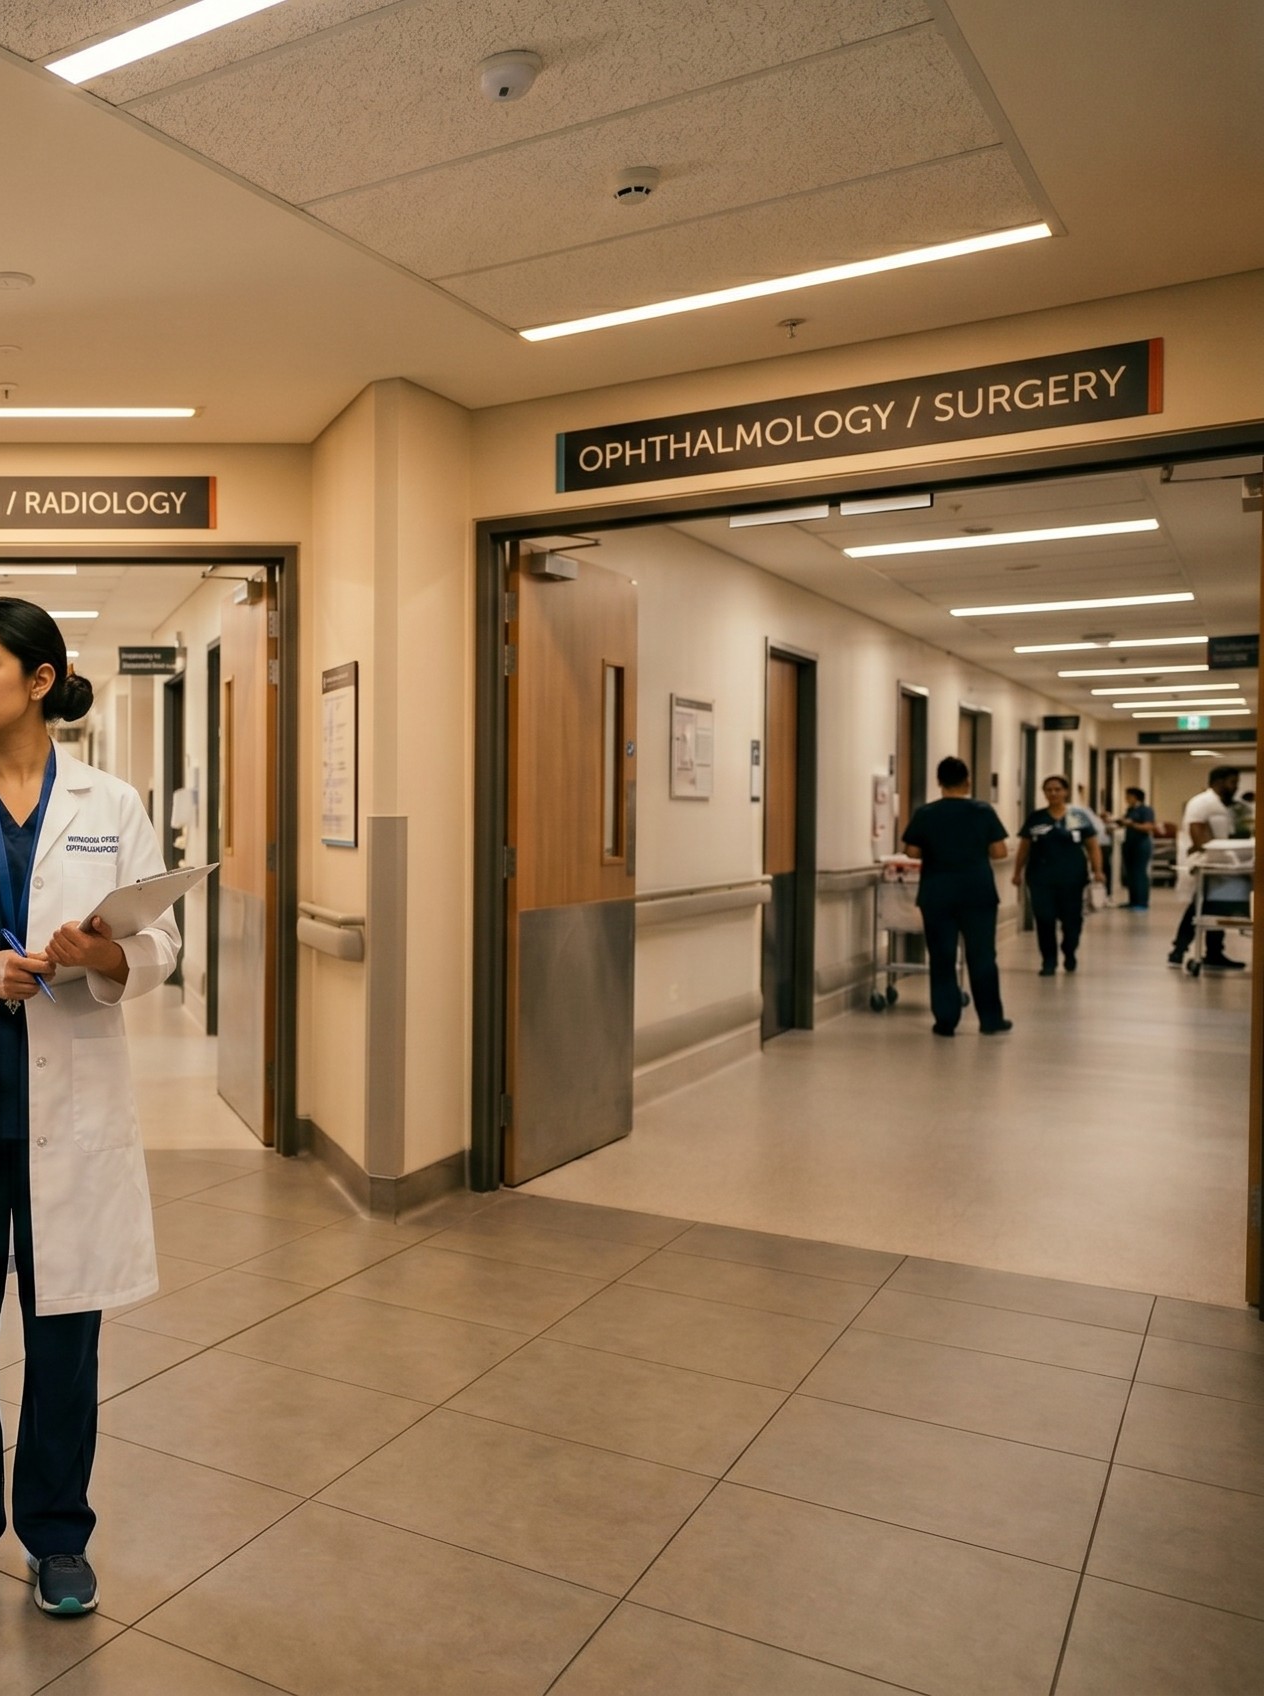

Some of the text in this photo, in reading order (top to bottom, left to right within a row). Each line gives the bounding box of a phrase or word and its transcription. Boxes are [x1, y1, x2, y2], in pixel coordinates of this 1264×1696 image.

[577, 365, 1127, 473] OPHTHALMOLOGY / SURGERY
[6, 490, 16, 518] /
[24, 490, 187, 516] RADIOLOGY
